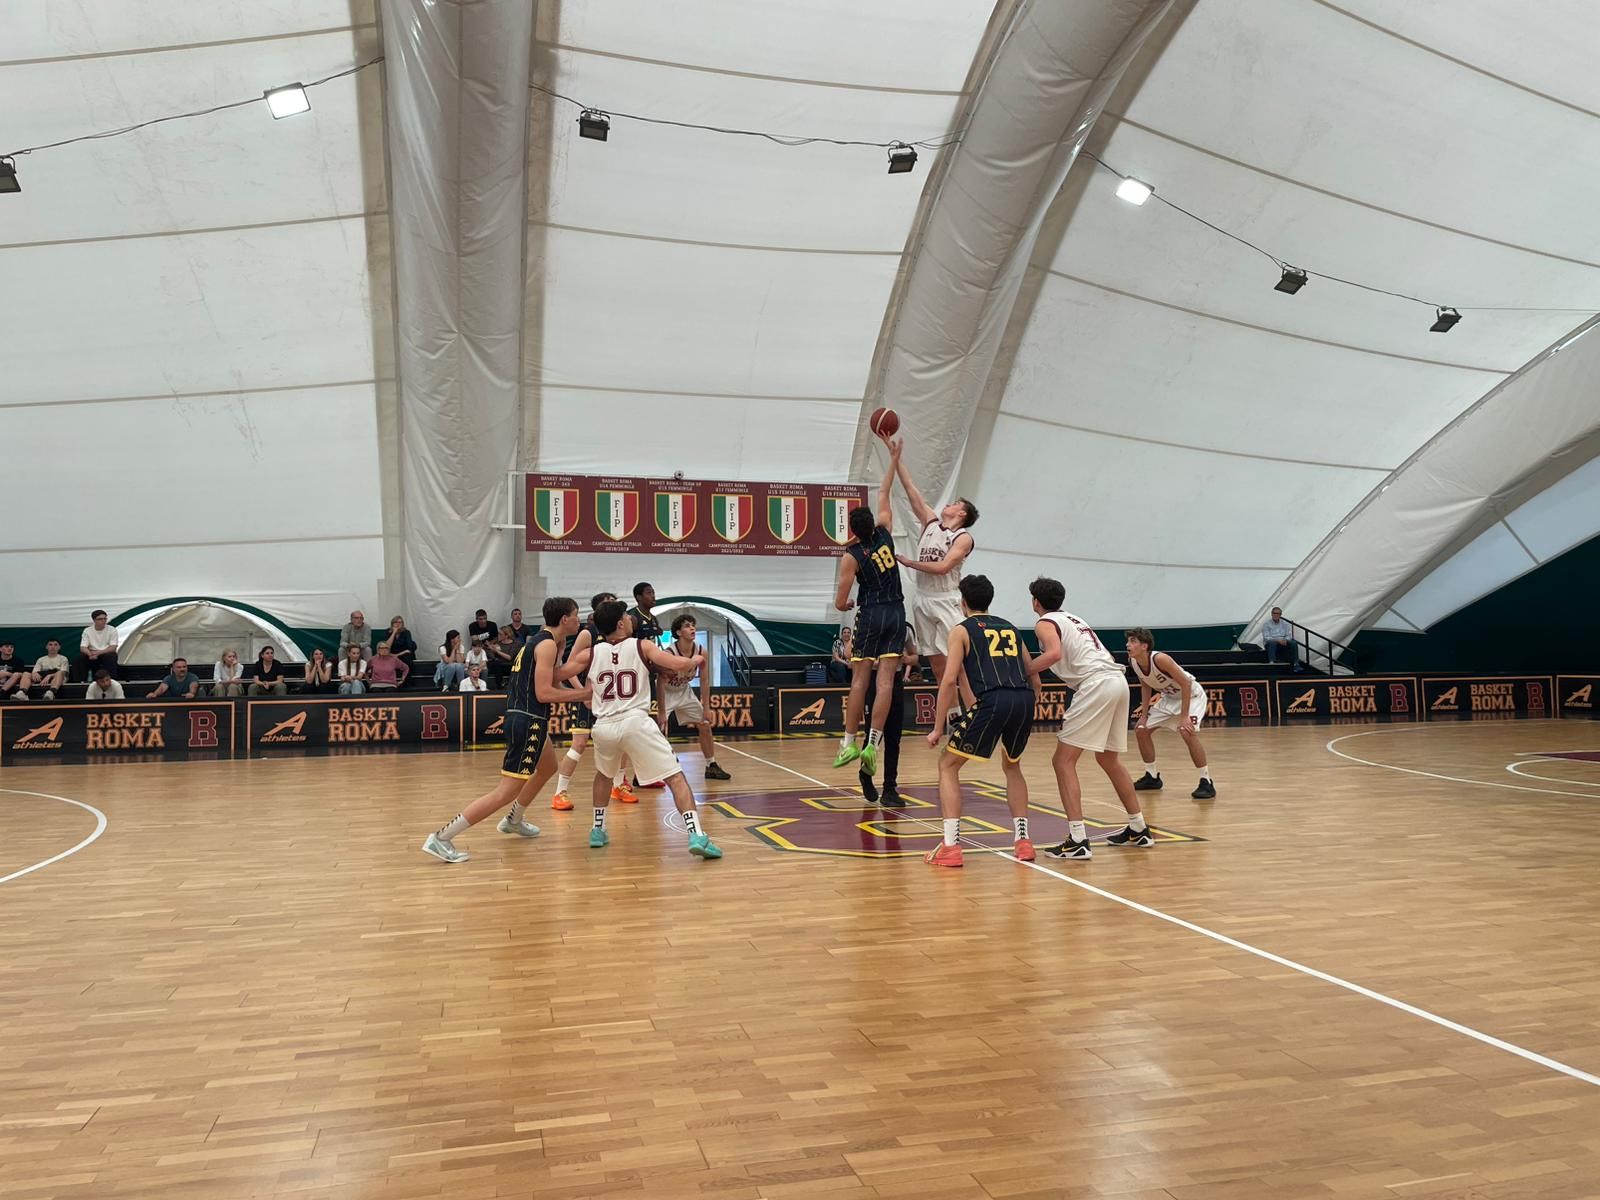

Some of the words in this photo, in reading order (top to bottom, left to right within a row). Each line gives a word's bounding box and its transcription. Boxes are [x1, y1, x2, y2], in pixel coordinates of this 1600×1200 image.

[871, 544, 895, 573] 18
[984, 630, 1018, 656] 23
[597, 670, 638, 702] 20
[1328, 685, 1376, 697] BASKET
[1470, 684, 1514, 695] BASKET
[705, 694, 754, 708] SKET
[1040, 691, 1066, 703] KET
[1330, 697, 1377, 713] ROMA
[1472, 695, 1516, 711] ROMA
[86, 712, 166, 728] BASKET
[328, 706, 400, 722] BASKET
[1034, 704, 1065, 720] MA
[86, 728, 166, 749] ROMA
[328, 722, 400, 743] ROMA
